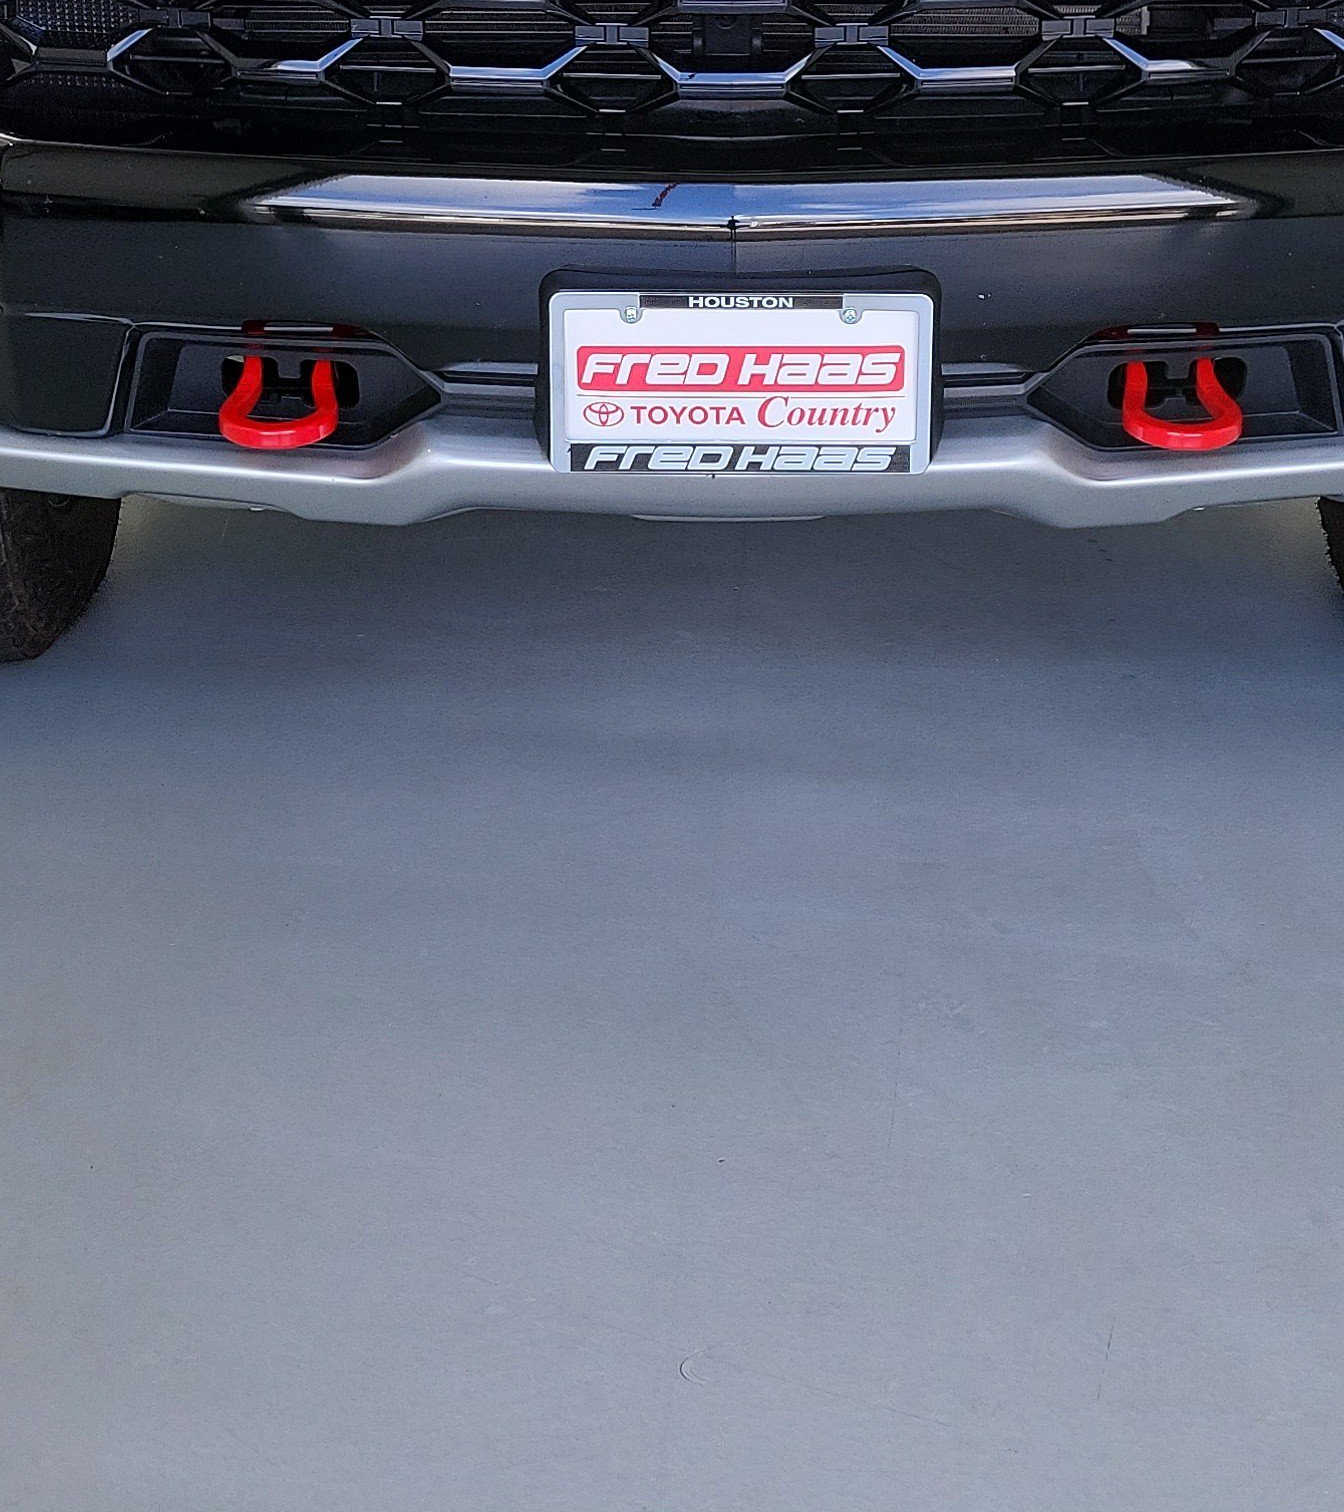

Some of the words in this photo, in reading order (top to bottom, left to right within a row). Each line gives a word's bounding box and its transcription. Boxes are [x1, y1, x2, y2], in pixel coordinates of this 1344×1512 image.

[688, 296, 794, 309] HOUSTON
[630, 405, 746, 426] TOYOTA
[757, 395, 896, 433] Country
